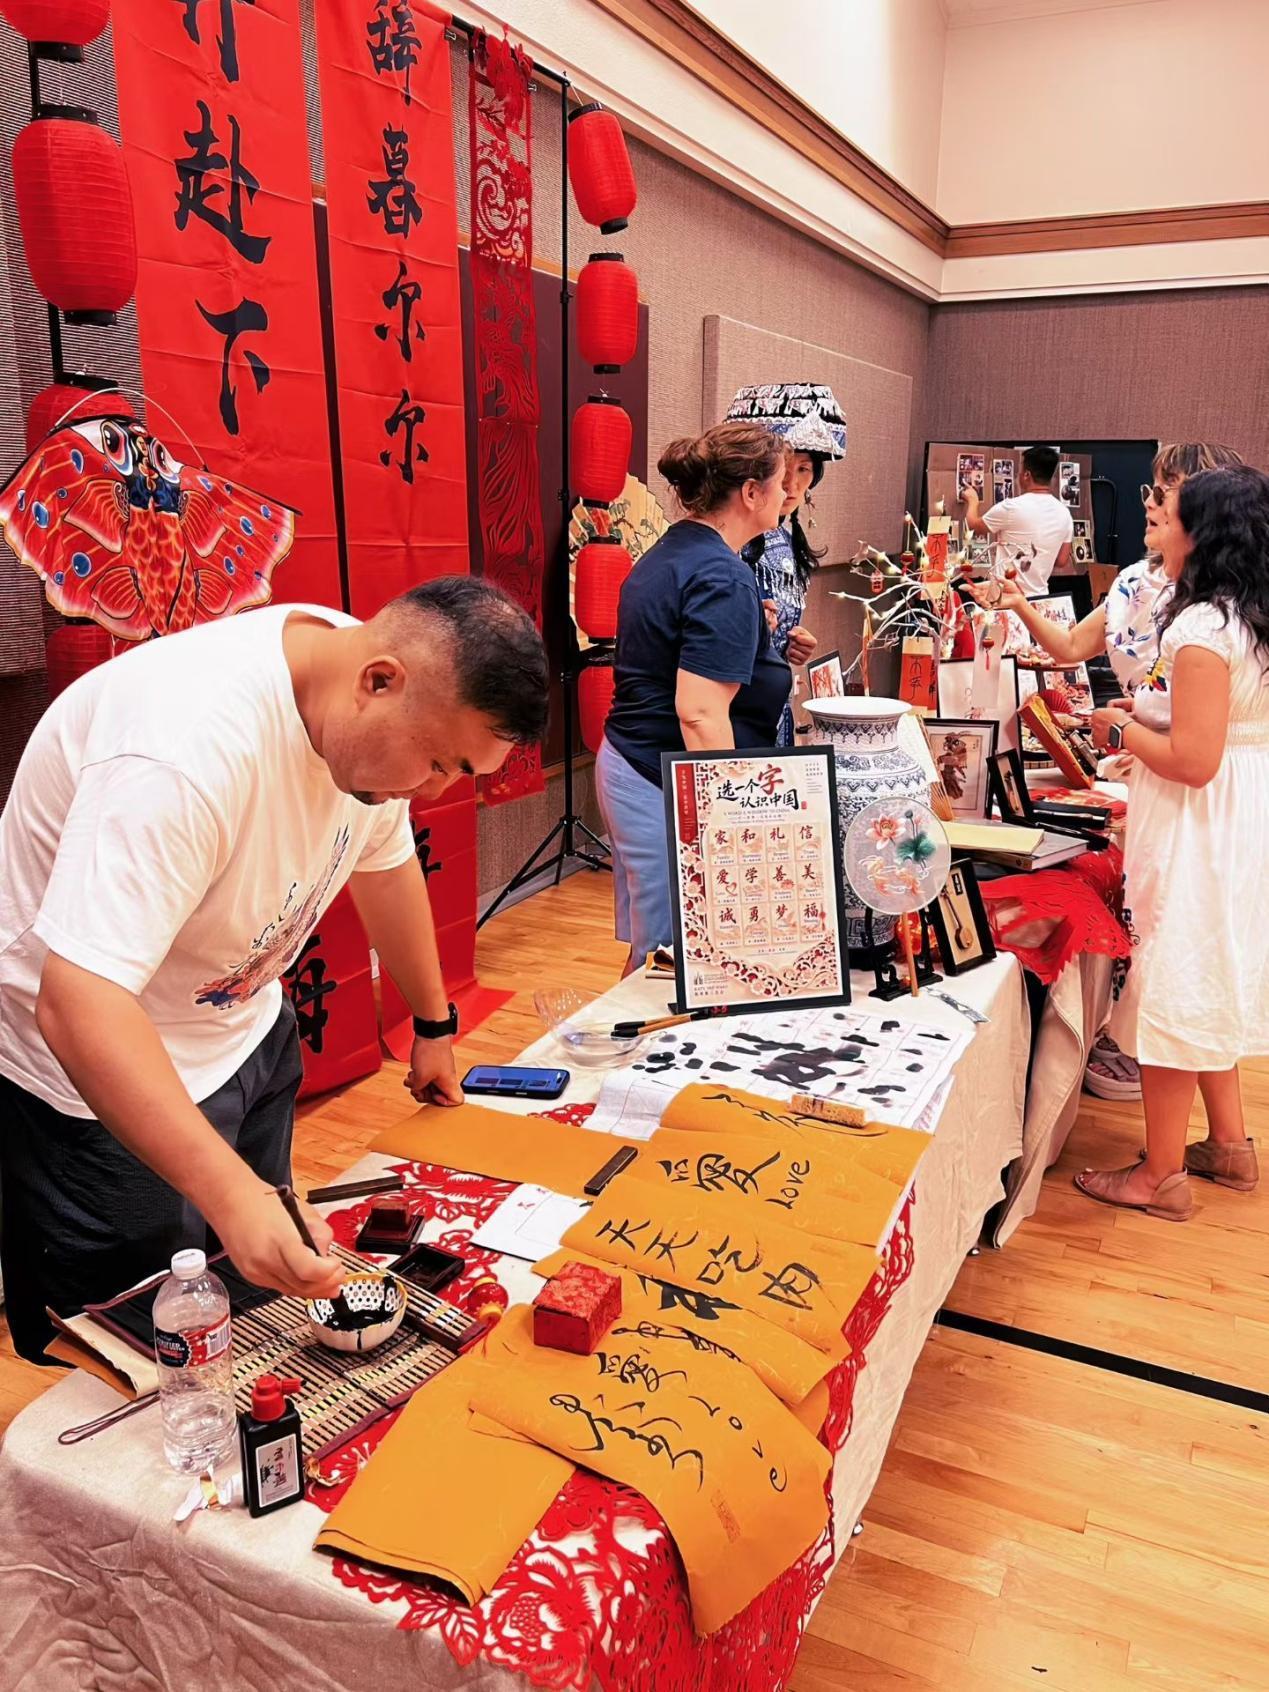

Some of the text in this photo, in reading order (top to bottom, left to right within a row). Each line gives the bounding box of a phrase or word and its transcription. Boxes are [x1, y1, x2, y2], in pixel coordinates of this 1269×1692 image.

[716, 763, 785, 802] 选一个字
[740, 788, 800, 811] 认识中国
[714, 825, 814, 845] 家 和 礼 信
[716, 863, 816, 885] 爱 学 善 美
[719, 902, 819, 924] 诚 勇 梦 福
[595, 1218, 824, 1311] 天天吃肉
